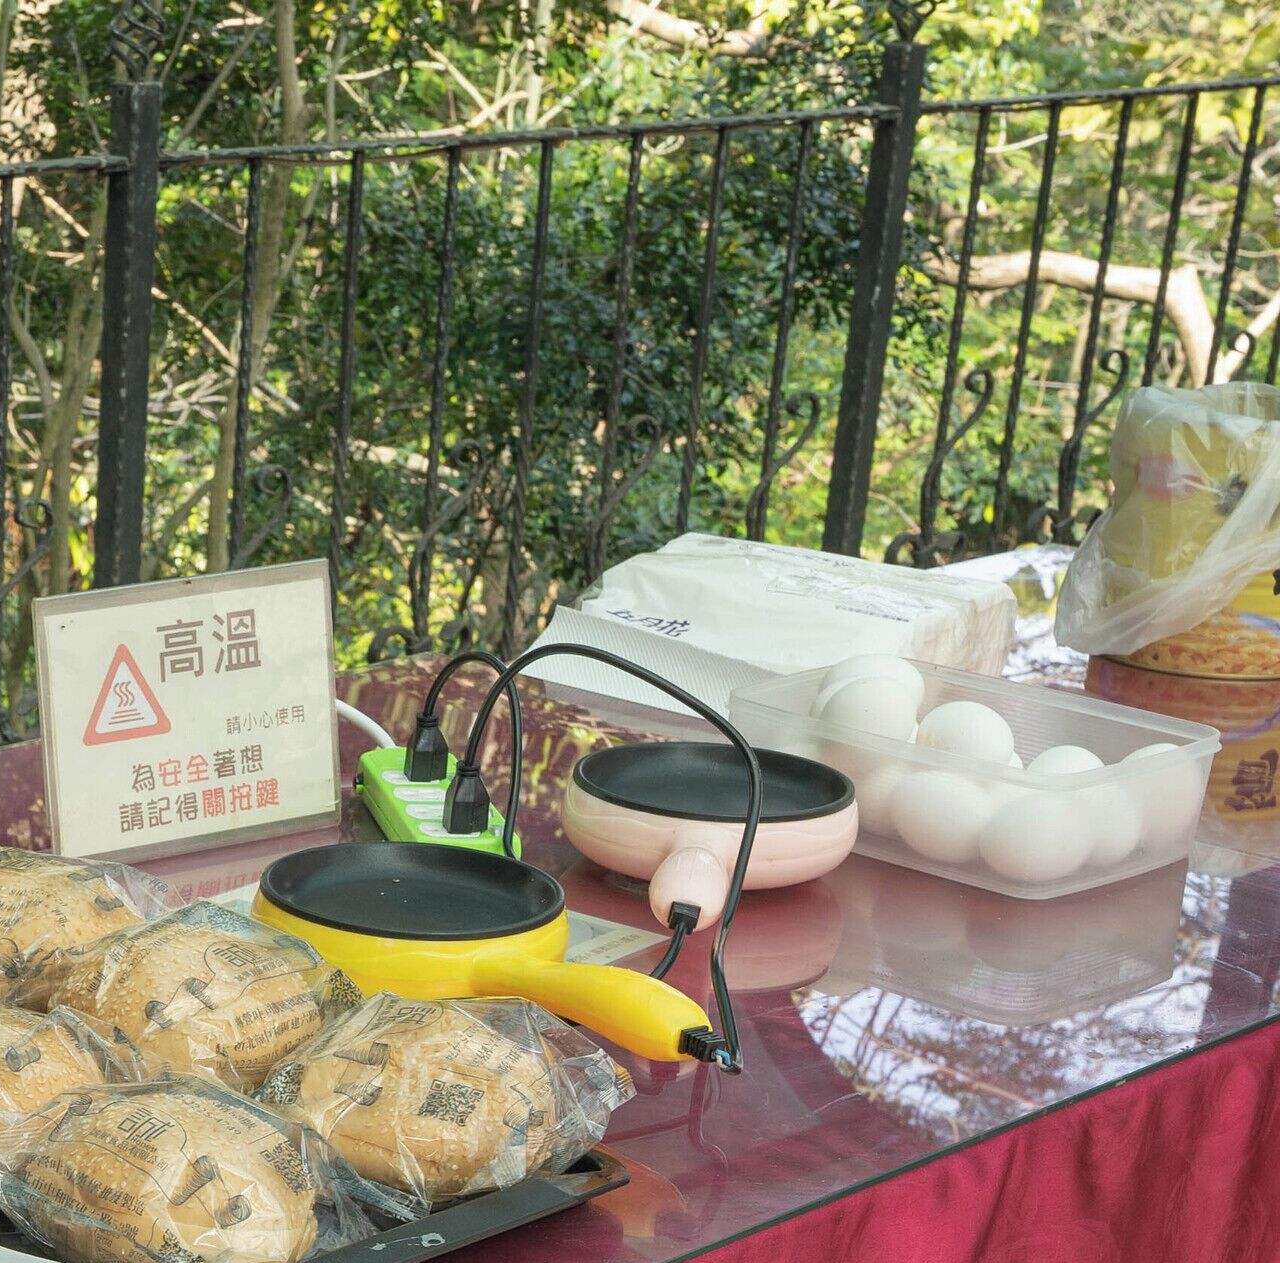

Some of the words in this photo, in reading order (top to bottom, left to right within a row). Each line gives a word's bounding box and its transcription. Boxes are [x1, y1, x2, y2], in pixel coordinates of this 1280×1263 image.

[155, 608, 262, 683] 高溫
[226, 705, 305, 735] 請小心使用
[131, 744, 265, 793] 為安全著想
[119, 778, 280, 834] 請記得關按鍵
